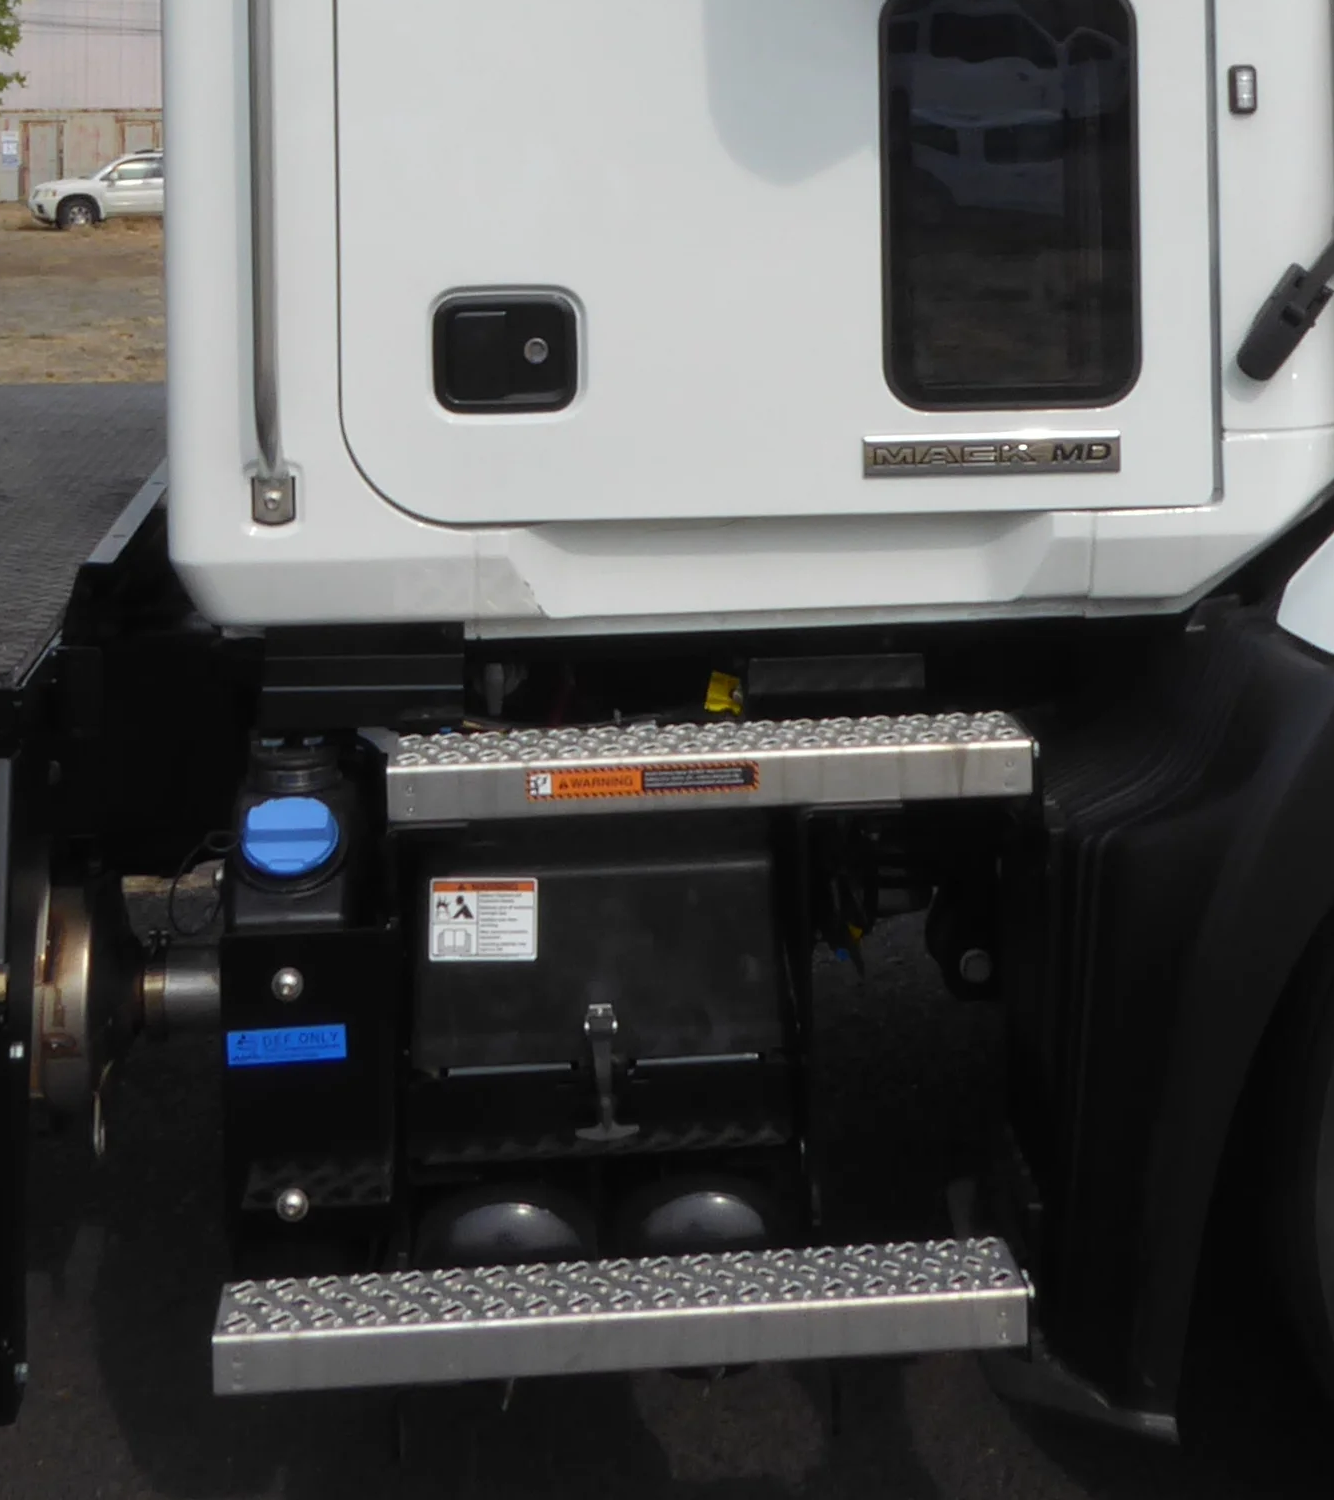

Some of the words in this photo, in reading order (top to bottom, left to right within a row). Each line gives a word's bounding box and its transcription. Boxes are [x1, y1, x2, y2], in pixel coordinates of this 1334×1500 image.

[872, 445, 1037, 466] MACK
[1050, 442, 1113, 464] MD
[570, 775, 634, 790] WARNING
[298, 1031, 339, 1045] ONLY
